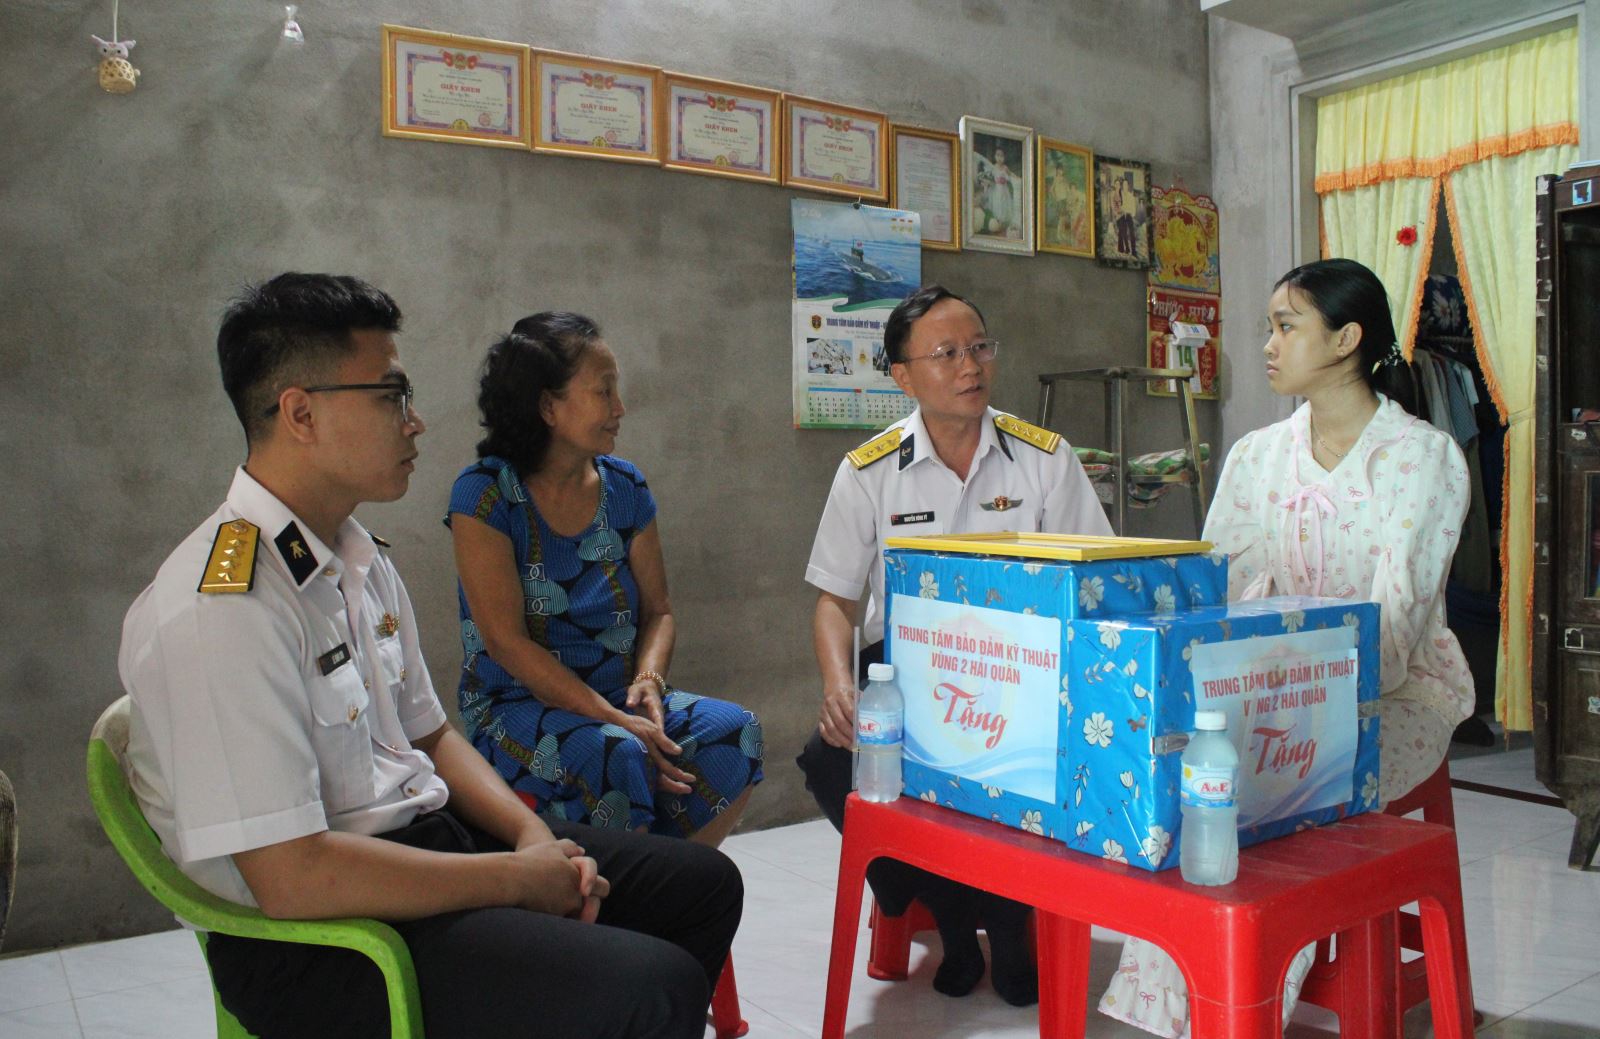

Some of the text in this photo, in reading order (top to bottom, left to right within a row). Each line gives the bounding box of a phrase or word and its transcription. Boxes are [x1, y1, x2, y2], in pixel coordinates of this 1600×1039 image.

[898, 625, 1058, 672] TRUNG TÂM BẢO ĐẢM KỸ THUẬT
[931, 651, 1021, 685] VÙNG 2 HẢI QUÂN
[1202, 677, 1240, 699] TRUNG
[1242, 673, 1265, 692] TÂM
[1289, 662, 1311, 684] ĐẢM
[1314, 660, 1325, 680] KỸ
[1327, 656, 1356, 679] THUẬT
[933, 683, 1008, 749] Tặng
[1243, 685, 1327, 717] VNG 2 HẢI QUÂN
[1249, 723, 1317, 779] Tặng
